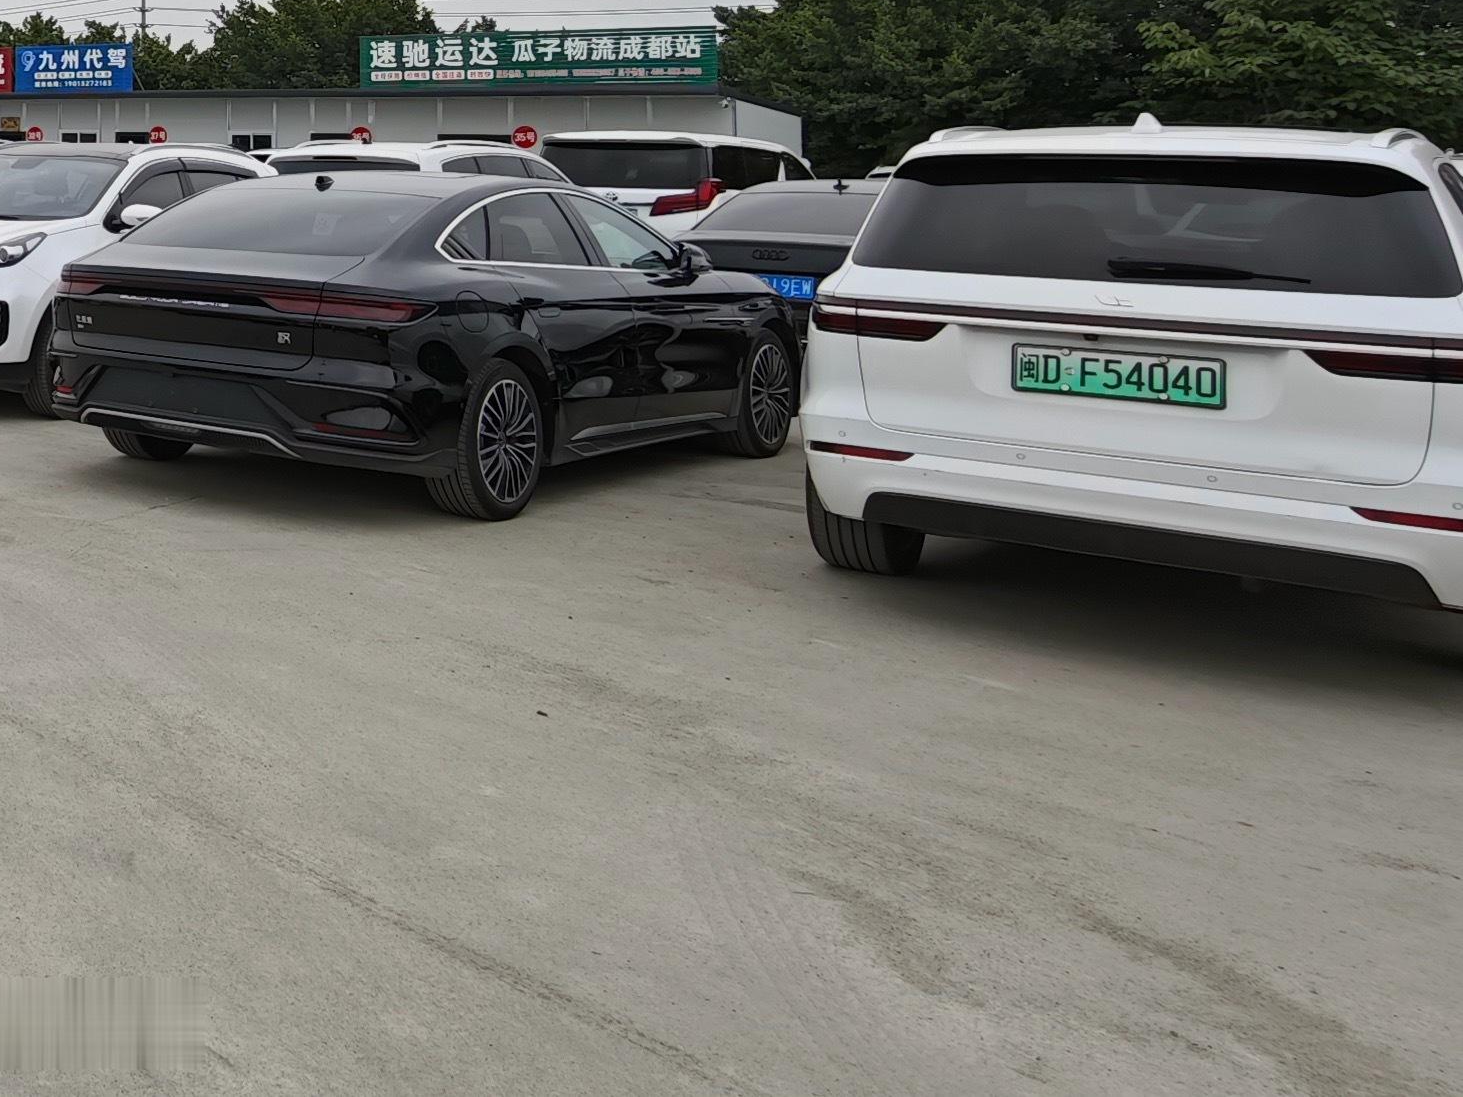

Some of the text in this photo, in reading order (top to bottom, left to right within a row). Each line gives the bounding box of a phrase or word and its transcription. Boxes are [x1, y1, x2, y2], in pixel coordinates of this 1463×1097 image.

[38, 48, 127, 71] 九州代驾
[369, 35, 702, 68] 速驰运达 瓜子物流成都站
[514, 131, 536, 143] 35号
